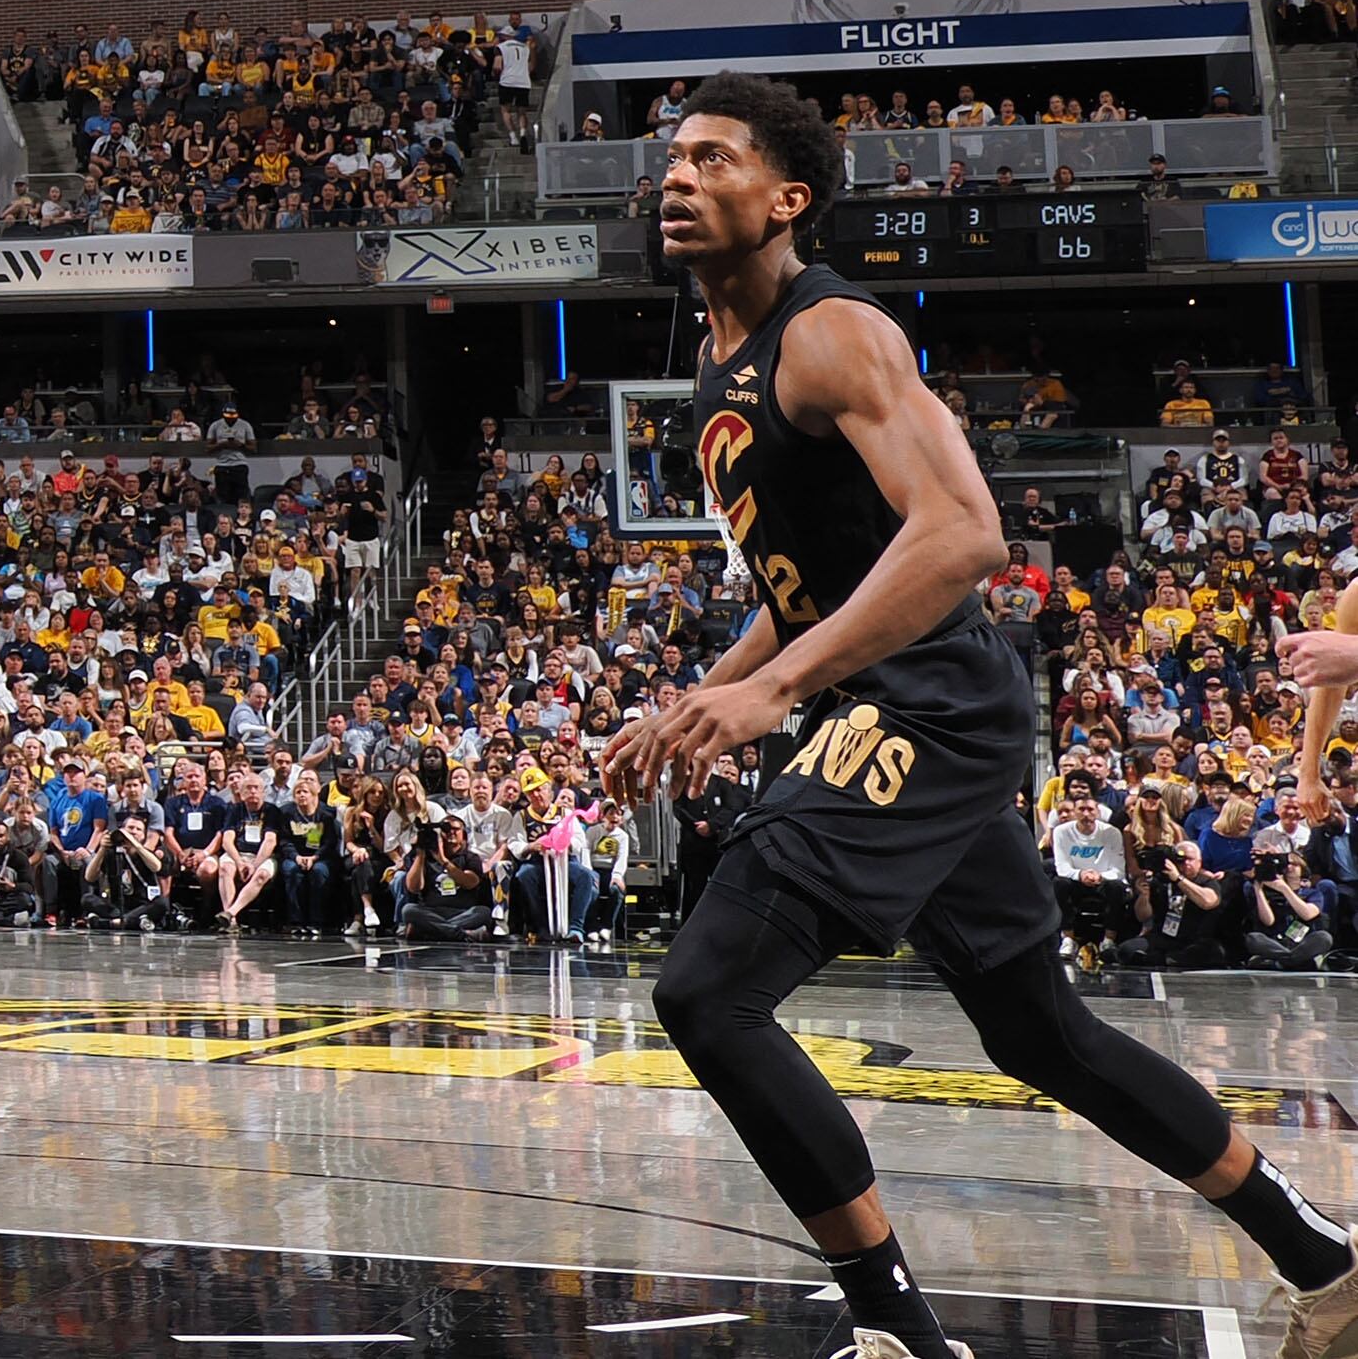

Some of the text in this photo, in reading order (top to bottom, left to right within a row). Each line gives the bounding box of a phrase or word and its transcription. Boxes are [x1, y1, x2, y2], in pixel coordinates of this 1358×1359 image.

[841, 19, 960, 50] FLIGHT
[878, 50, 926, 66] DECK
[874, 212, 926, 236] 3:28
[969, 208, 980, 226] 3
[1041, 204, 1096, 226] CAVS
[1283, 223, 1304, 232] and
[485, 234, 596, 258] XIBER
[59, 251, 114, 266] CITY
[125, 249, 188, 264] WIDE
[500, 254, 595, 272] INTERNET
[864, 247, 928, 264] PERIOD 3
[122, 267, 189, 275] SOLUTIONS
[725, 389, 759, 404] CLIFFS
[783, 717, 916, 806] AVS
